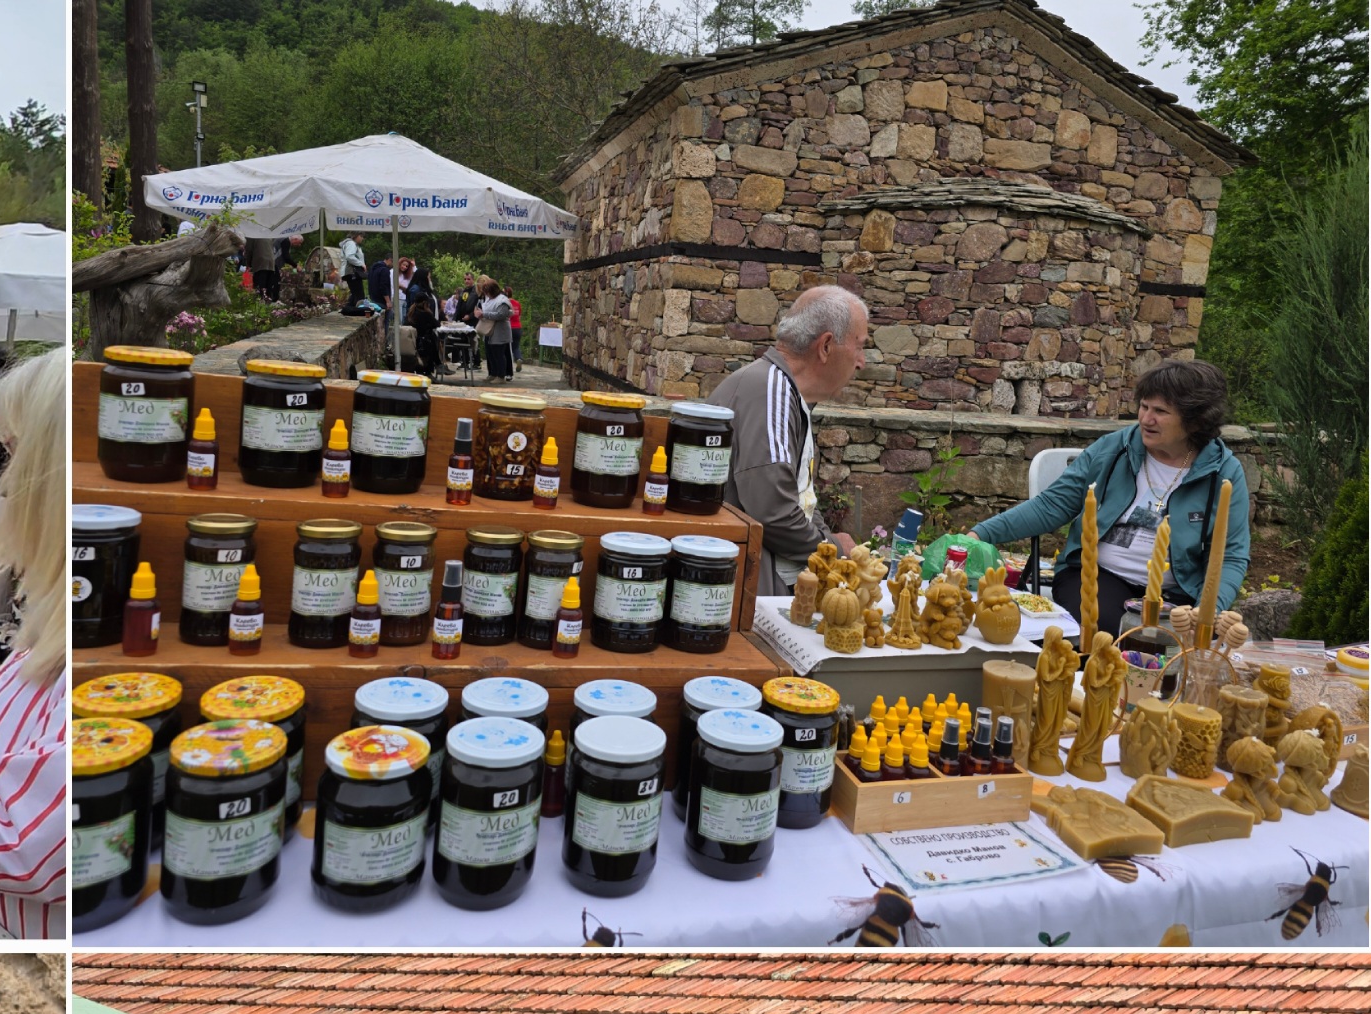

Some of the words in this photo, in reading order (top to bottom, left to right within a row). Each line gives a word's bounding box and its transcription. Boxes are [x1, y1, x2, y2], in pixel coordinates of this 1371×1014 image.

[187, 190, 227, 206] Горна
[229, 189, 265, 204] Баня
[389, 193, 429, 211] Горна
[431, 195, 468, 209] Баня
[125, 383, 140, 394] 20
[291, 395, 304, 406] 20
[610, 426, 622, 435] 20
[708, 437, 720, 446] 20
[510, 465, 521, 475] 15
[225, 550, 238, 563] 10
[406, 558, 416, 568] 10
[627, 568, 637, 578] 16
[800, 729, 814, 741] 20
[1346, 734, 1355, 743] 15
[499, 792, 516, 807] 20
[225, 799, 248, 818] 20
[480, 811, 520, 833] Мед
[207, 819, 256, 843] Мед
[889, 834, 942, 846] СОБСТВЕНО
[940, 828, 1011, 842] ПРОИЗВОДСТВО
[926, 847, 971, 858] Давидко
[971, 844, 1007, 853] Манов
[958, 852, 1001, 862] Габрово
